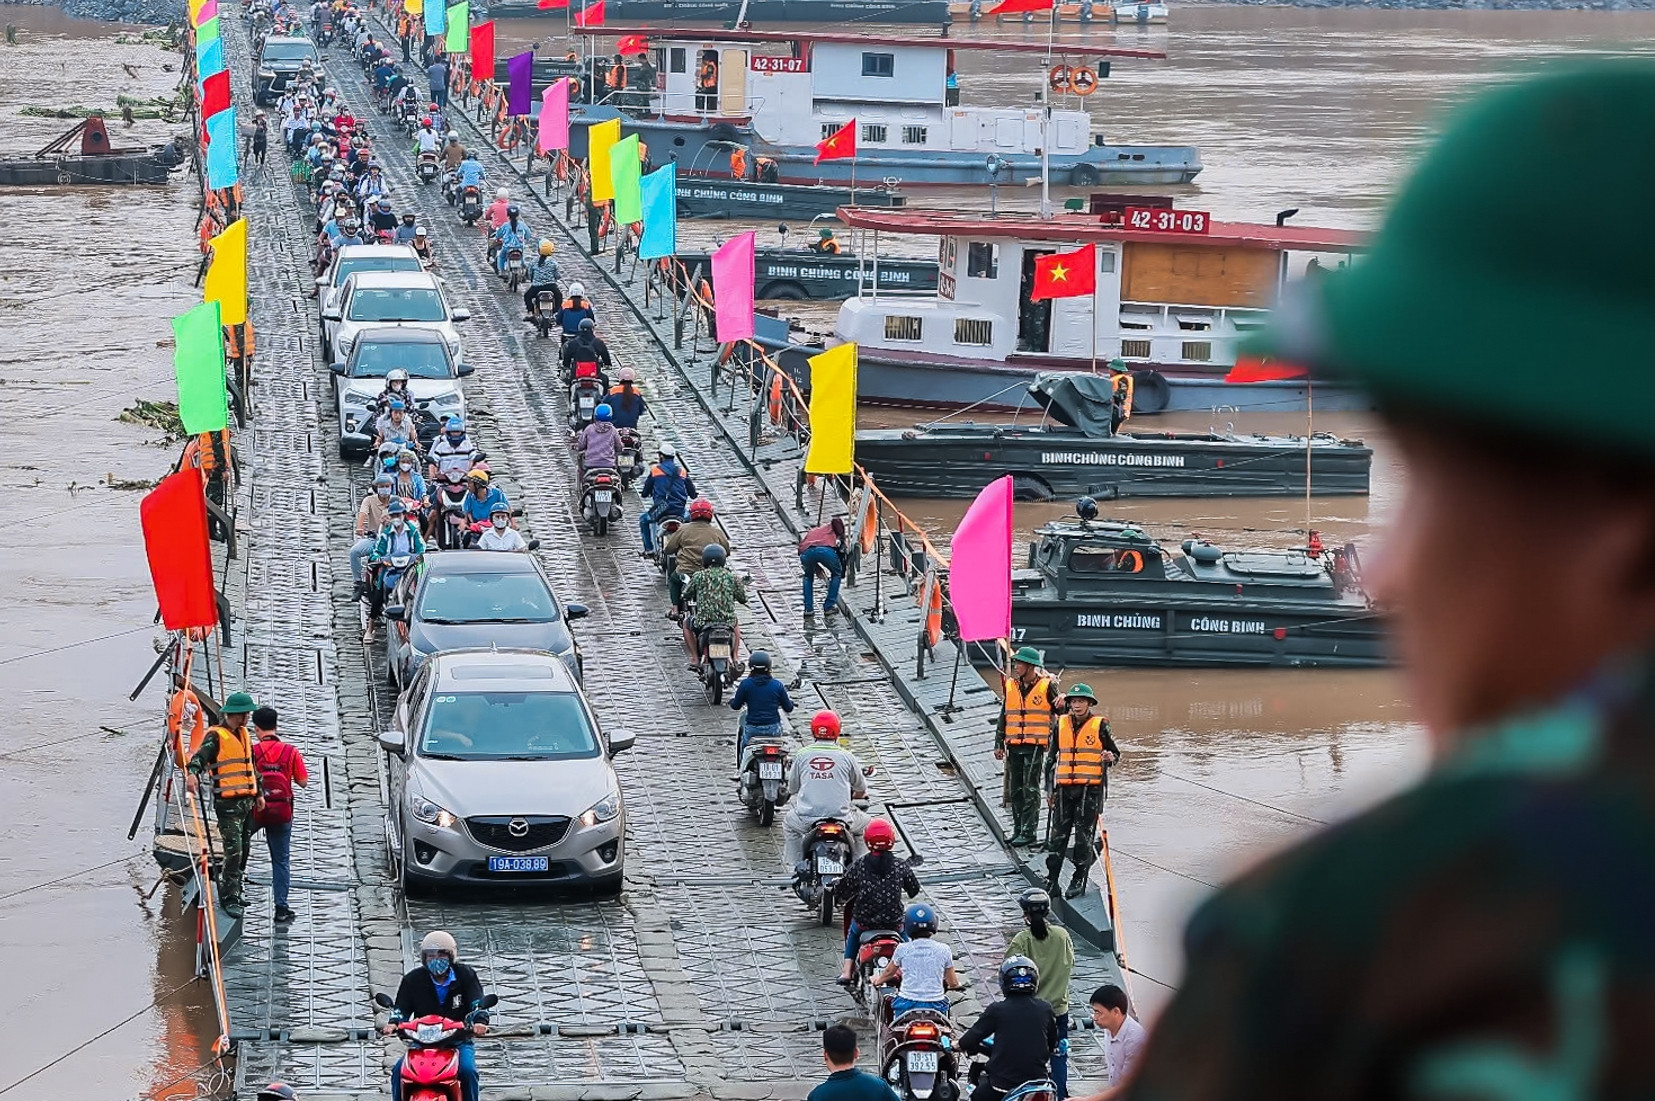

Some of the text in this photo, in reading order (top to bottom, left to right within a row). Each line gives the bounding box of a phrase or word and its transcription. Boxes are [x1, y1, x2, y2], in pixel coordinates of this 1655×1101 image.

[754, 58, 802, 71] 42-31-07
[674, 188, 691, 198] INH
[1130, 210, 1204, 231] 42-31-03
[768, 266, 797, 277] BINH
[880, 271, 910, 283] BINH
[1153, 455, 1185, 467] BINH
[1077, 614, 1111, 628] BINH
[1190, 616, 1229, 632] CÔNG
[1231, 620, 1265, 634] BINH
[810, 772, 834, 780] TASA
